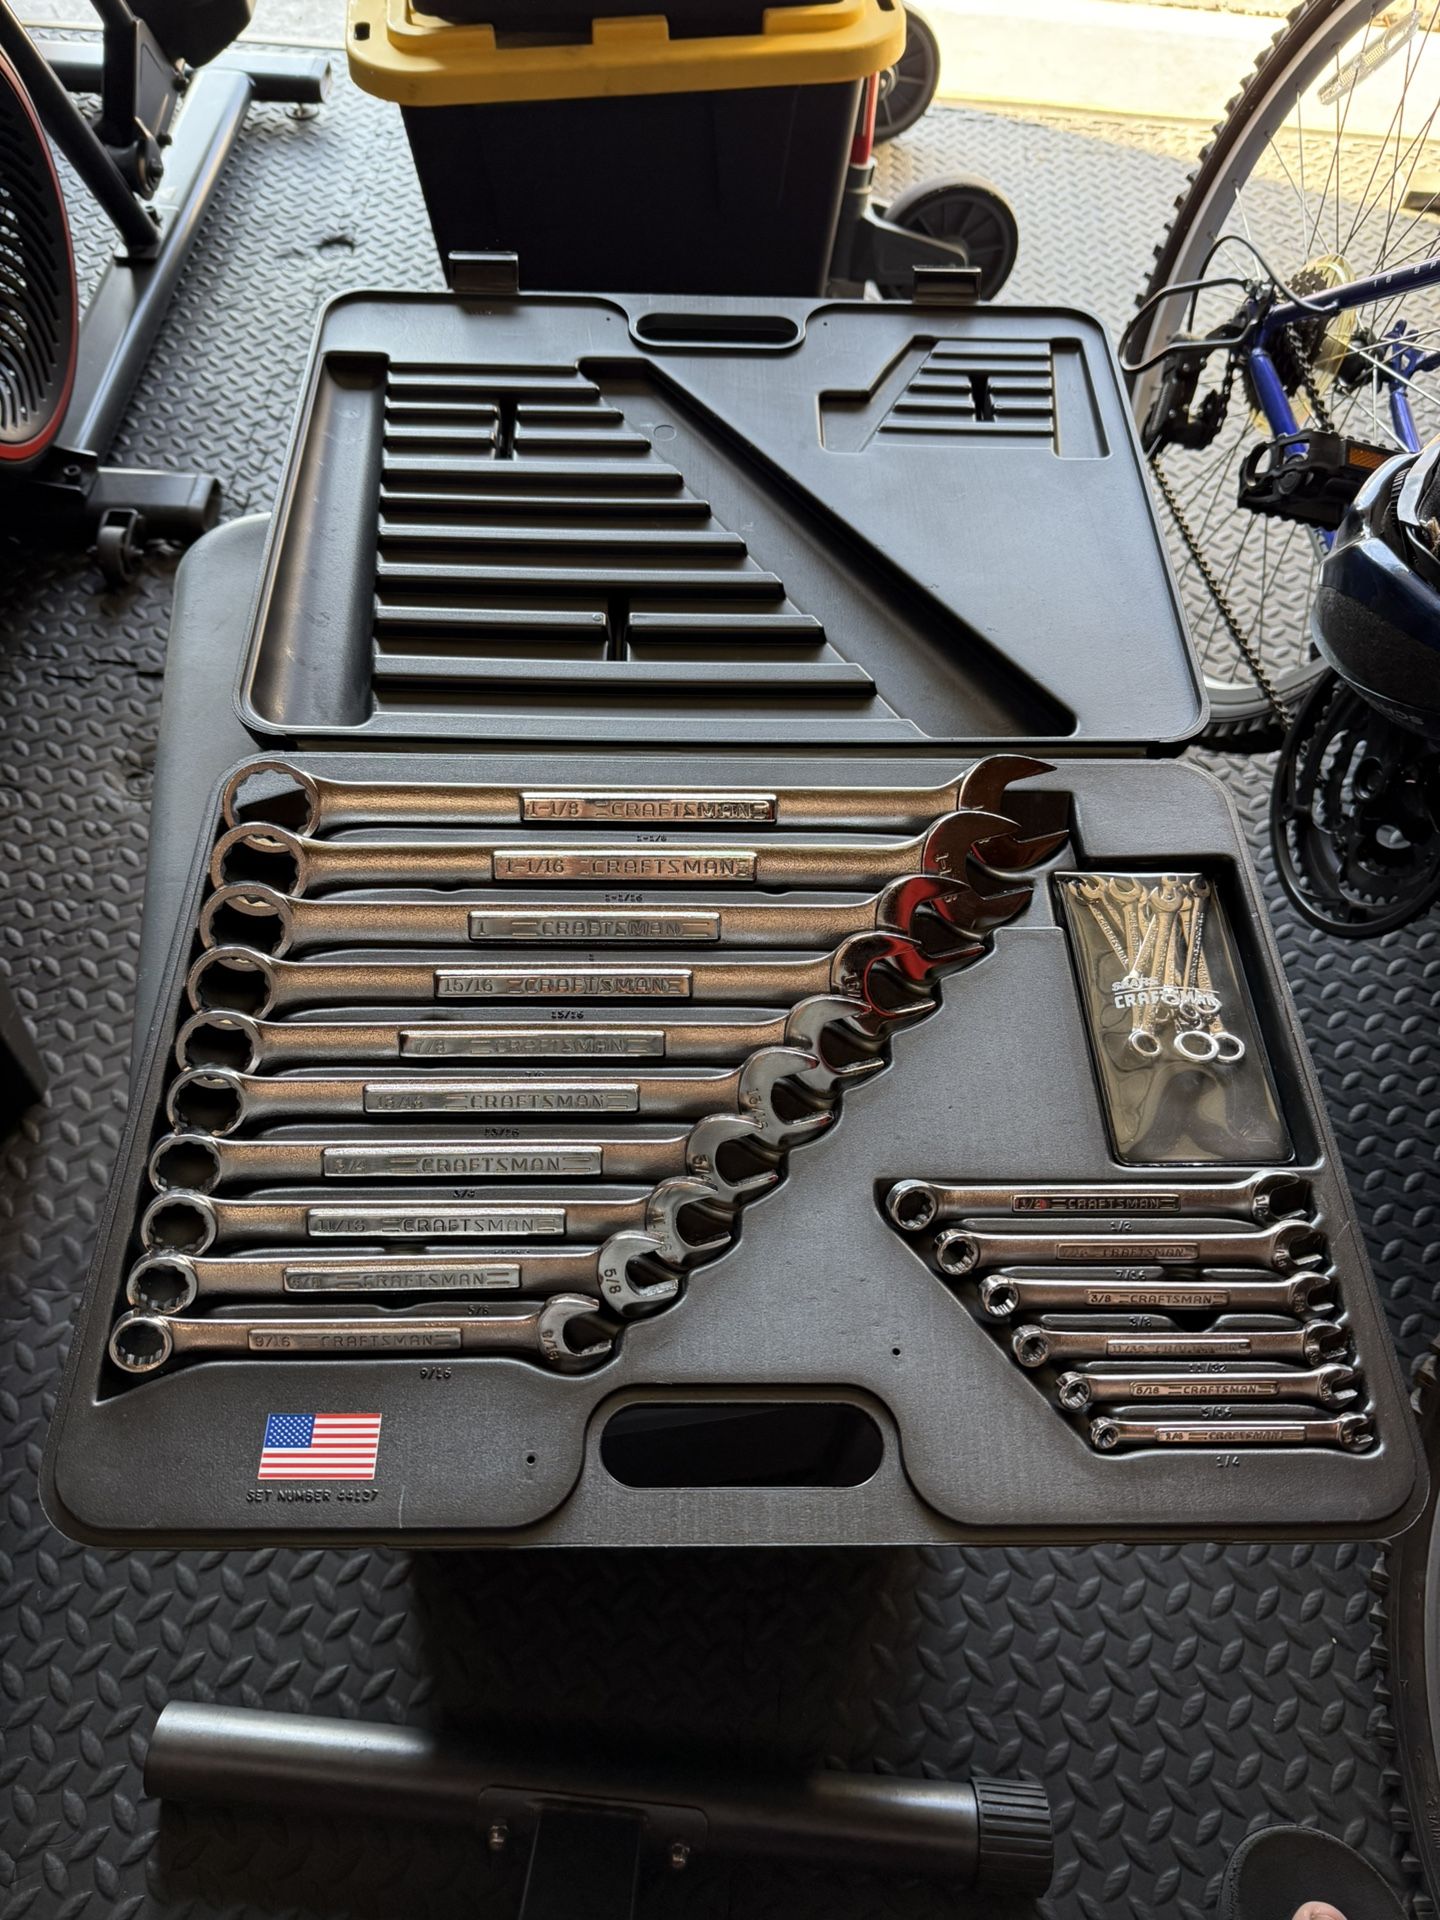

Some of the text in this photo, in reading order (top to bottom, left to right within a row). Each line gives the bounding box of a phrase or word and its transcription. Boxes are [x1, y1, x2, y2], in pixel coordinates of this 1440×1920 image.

[528, 801, 752, 818] 1-1/8 CRAFTSMAN
[504, 858, 736, 876] 1-1/16 CRAFTSMAN
[541, 919, 682, 937] CRAFTSMAN
[443, 977, 668, 995] 15/16 CRAFTSMAN
[493, 1038, 627, 1053] CRAFTSMAN
[470, 1093, 605, 1110] CRAFTSMAN
[420, 1156, 561, 1174] CRAFTSMAN
[1067, 1198, 1160, 1210] CRAFTSMAN
[402, 1217, 535, 1234] CRAFTSMAN
[1110, 1220, 1133, 1232] 1/2
[1103, 1247, 1186, 1258] CRAFTSMAN
[361, 1272, 486, 1288] CRAFTSMAN
[603, 1267, 622, 1295] 5/8
[1090, 1294, 1212, 1305] 3/8 CRAFTSMAN
[254, 1334, 434, 1348] 9/16 CRAFTSMAN
[419, 1367, 452, 1380] 9/16
[1183, 1385, 1258, 1396] CRAFTSMAN
[246, 1488, 273, 1503] SET
[277, 1488, 333, 1503] NUMBER
